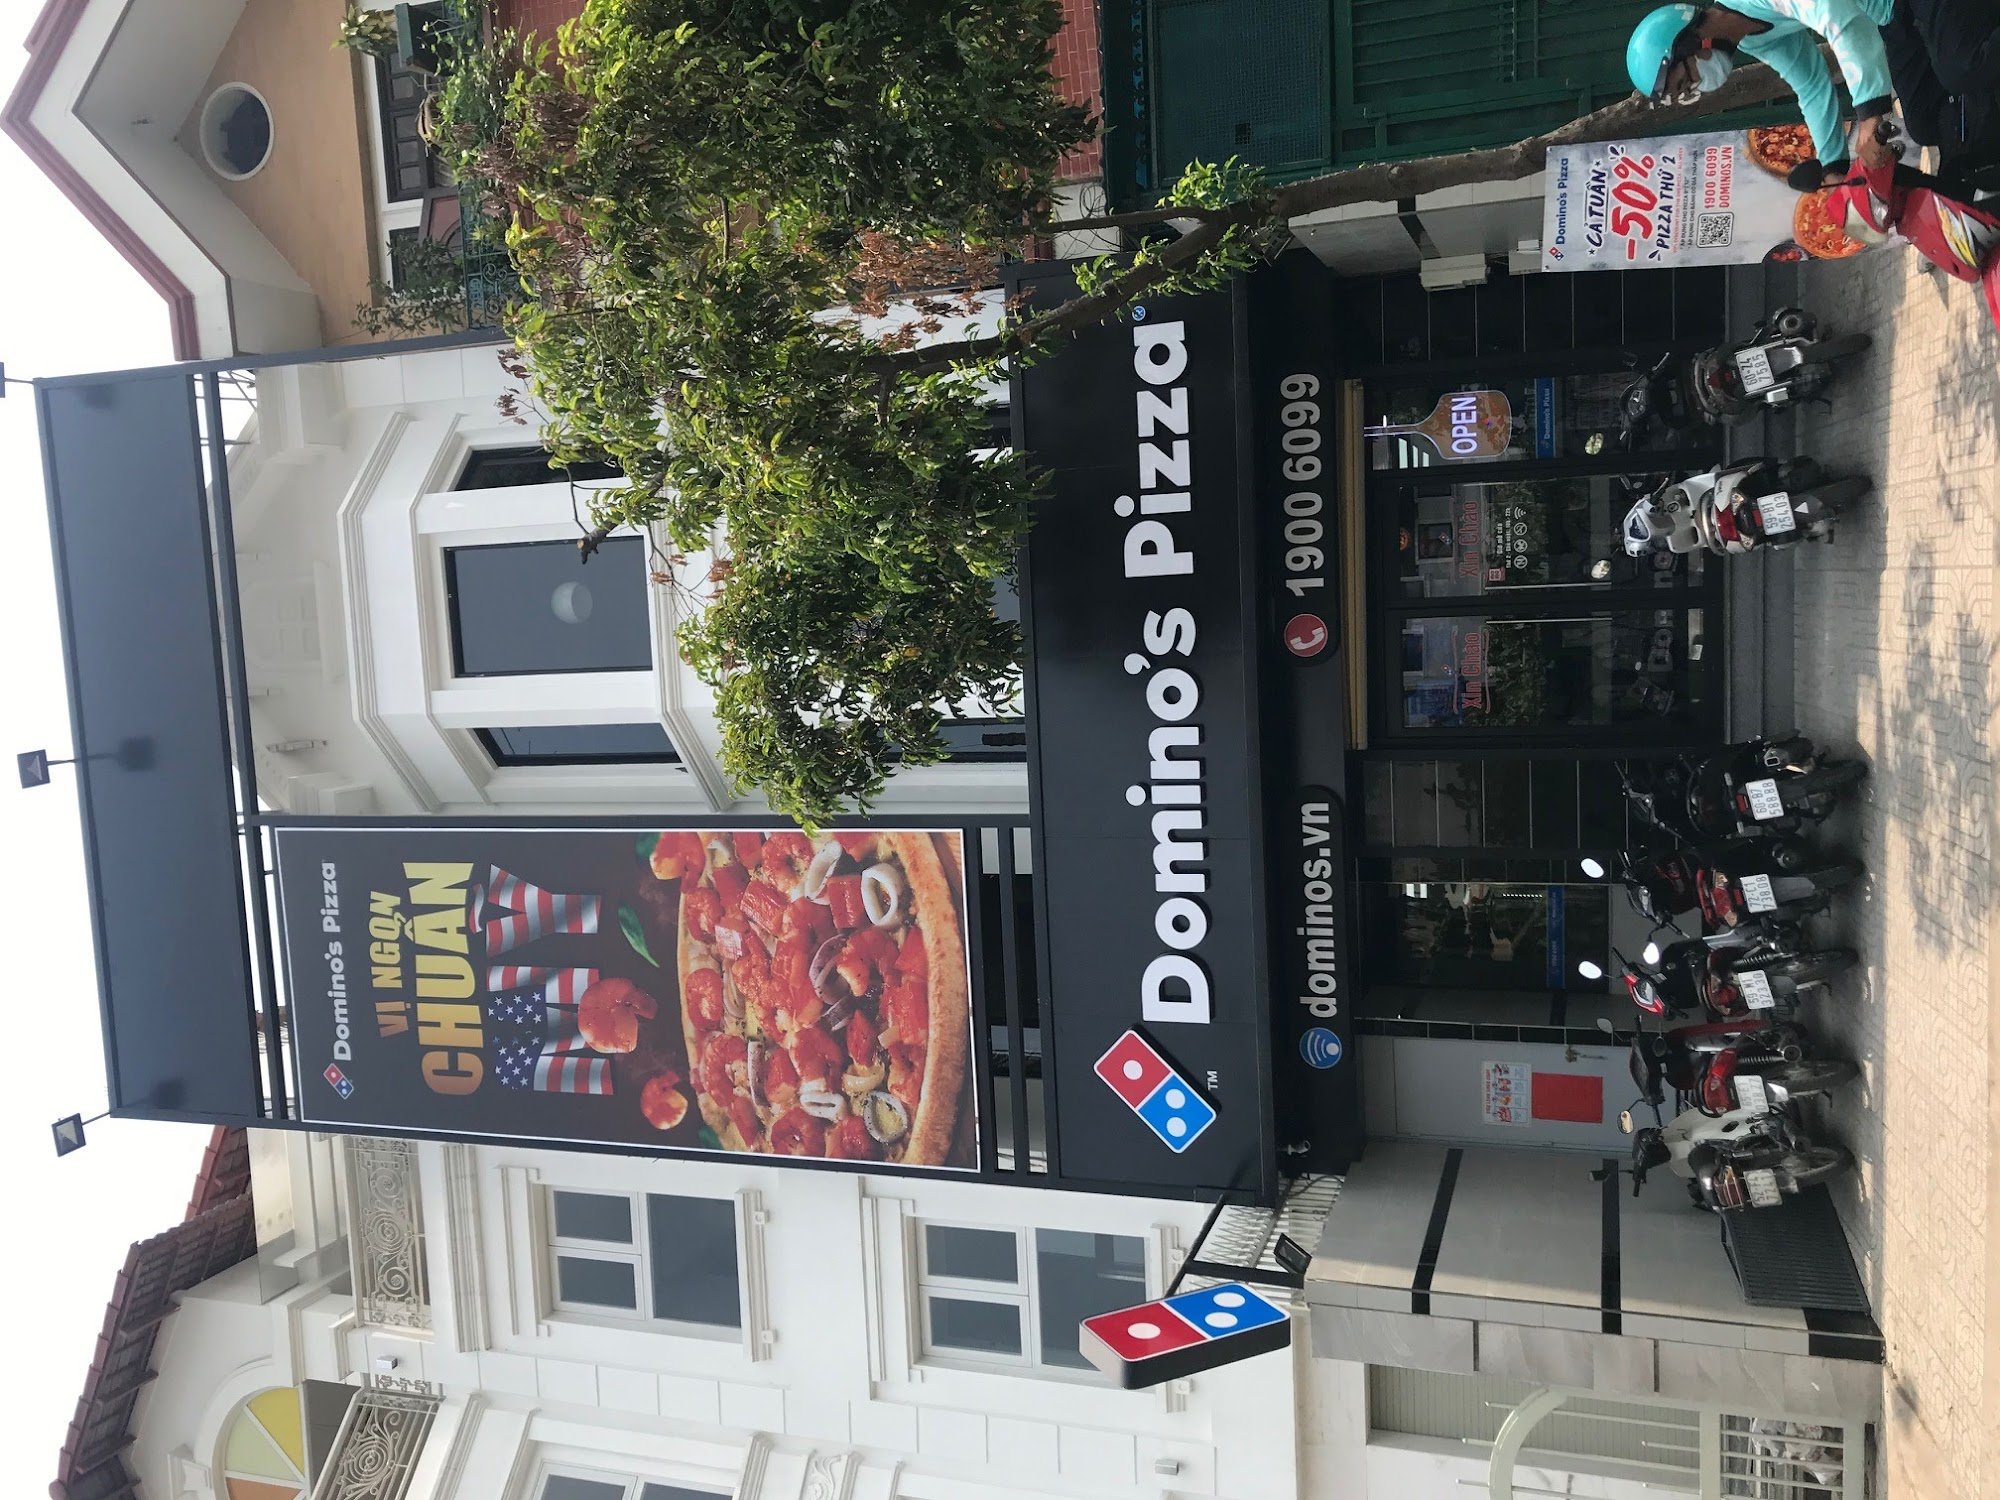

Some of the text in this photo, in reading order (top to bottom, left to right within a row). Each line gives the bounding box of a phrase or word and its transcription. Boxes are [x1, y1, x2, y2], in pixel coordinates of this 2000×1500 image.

[1555, 158, 1568, 245] Domino's Pizza
[1584, 169, 1606, 247] CẢ TUẦN
[1611, 155, 1658, 260] -50%
[1656, 155, 1676, 249] PIZZA THỨ 2
[1704, 148, 1717, 209] 1900 6099
[1719, 147, 1732, 208] DOMINOS.VN
[1752, 354, 1771, 382] 7585
[1451, 396, 1478, 454] OPEN
[1280, 374, 1325, 597] 1900 6099
[1113, 320, 1211, 1024] Domino's Pizza
[1461, 681, 1482, 709] Xin
[1296, 802, 1337, 1018] dominos.vn
[320, 862, 352, 1061] Domino's Pizza
[394, 862, 484, 1095] CHUẨN
[468, 863, 614, 1096] MỸ
[375, 1001, 411, 1037] VỊ
[1206, 1070, 1219, 1091] TM
